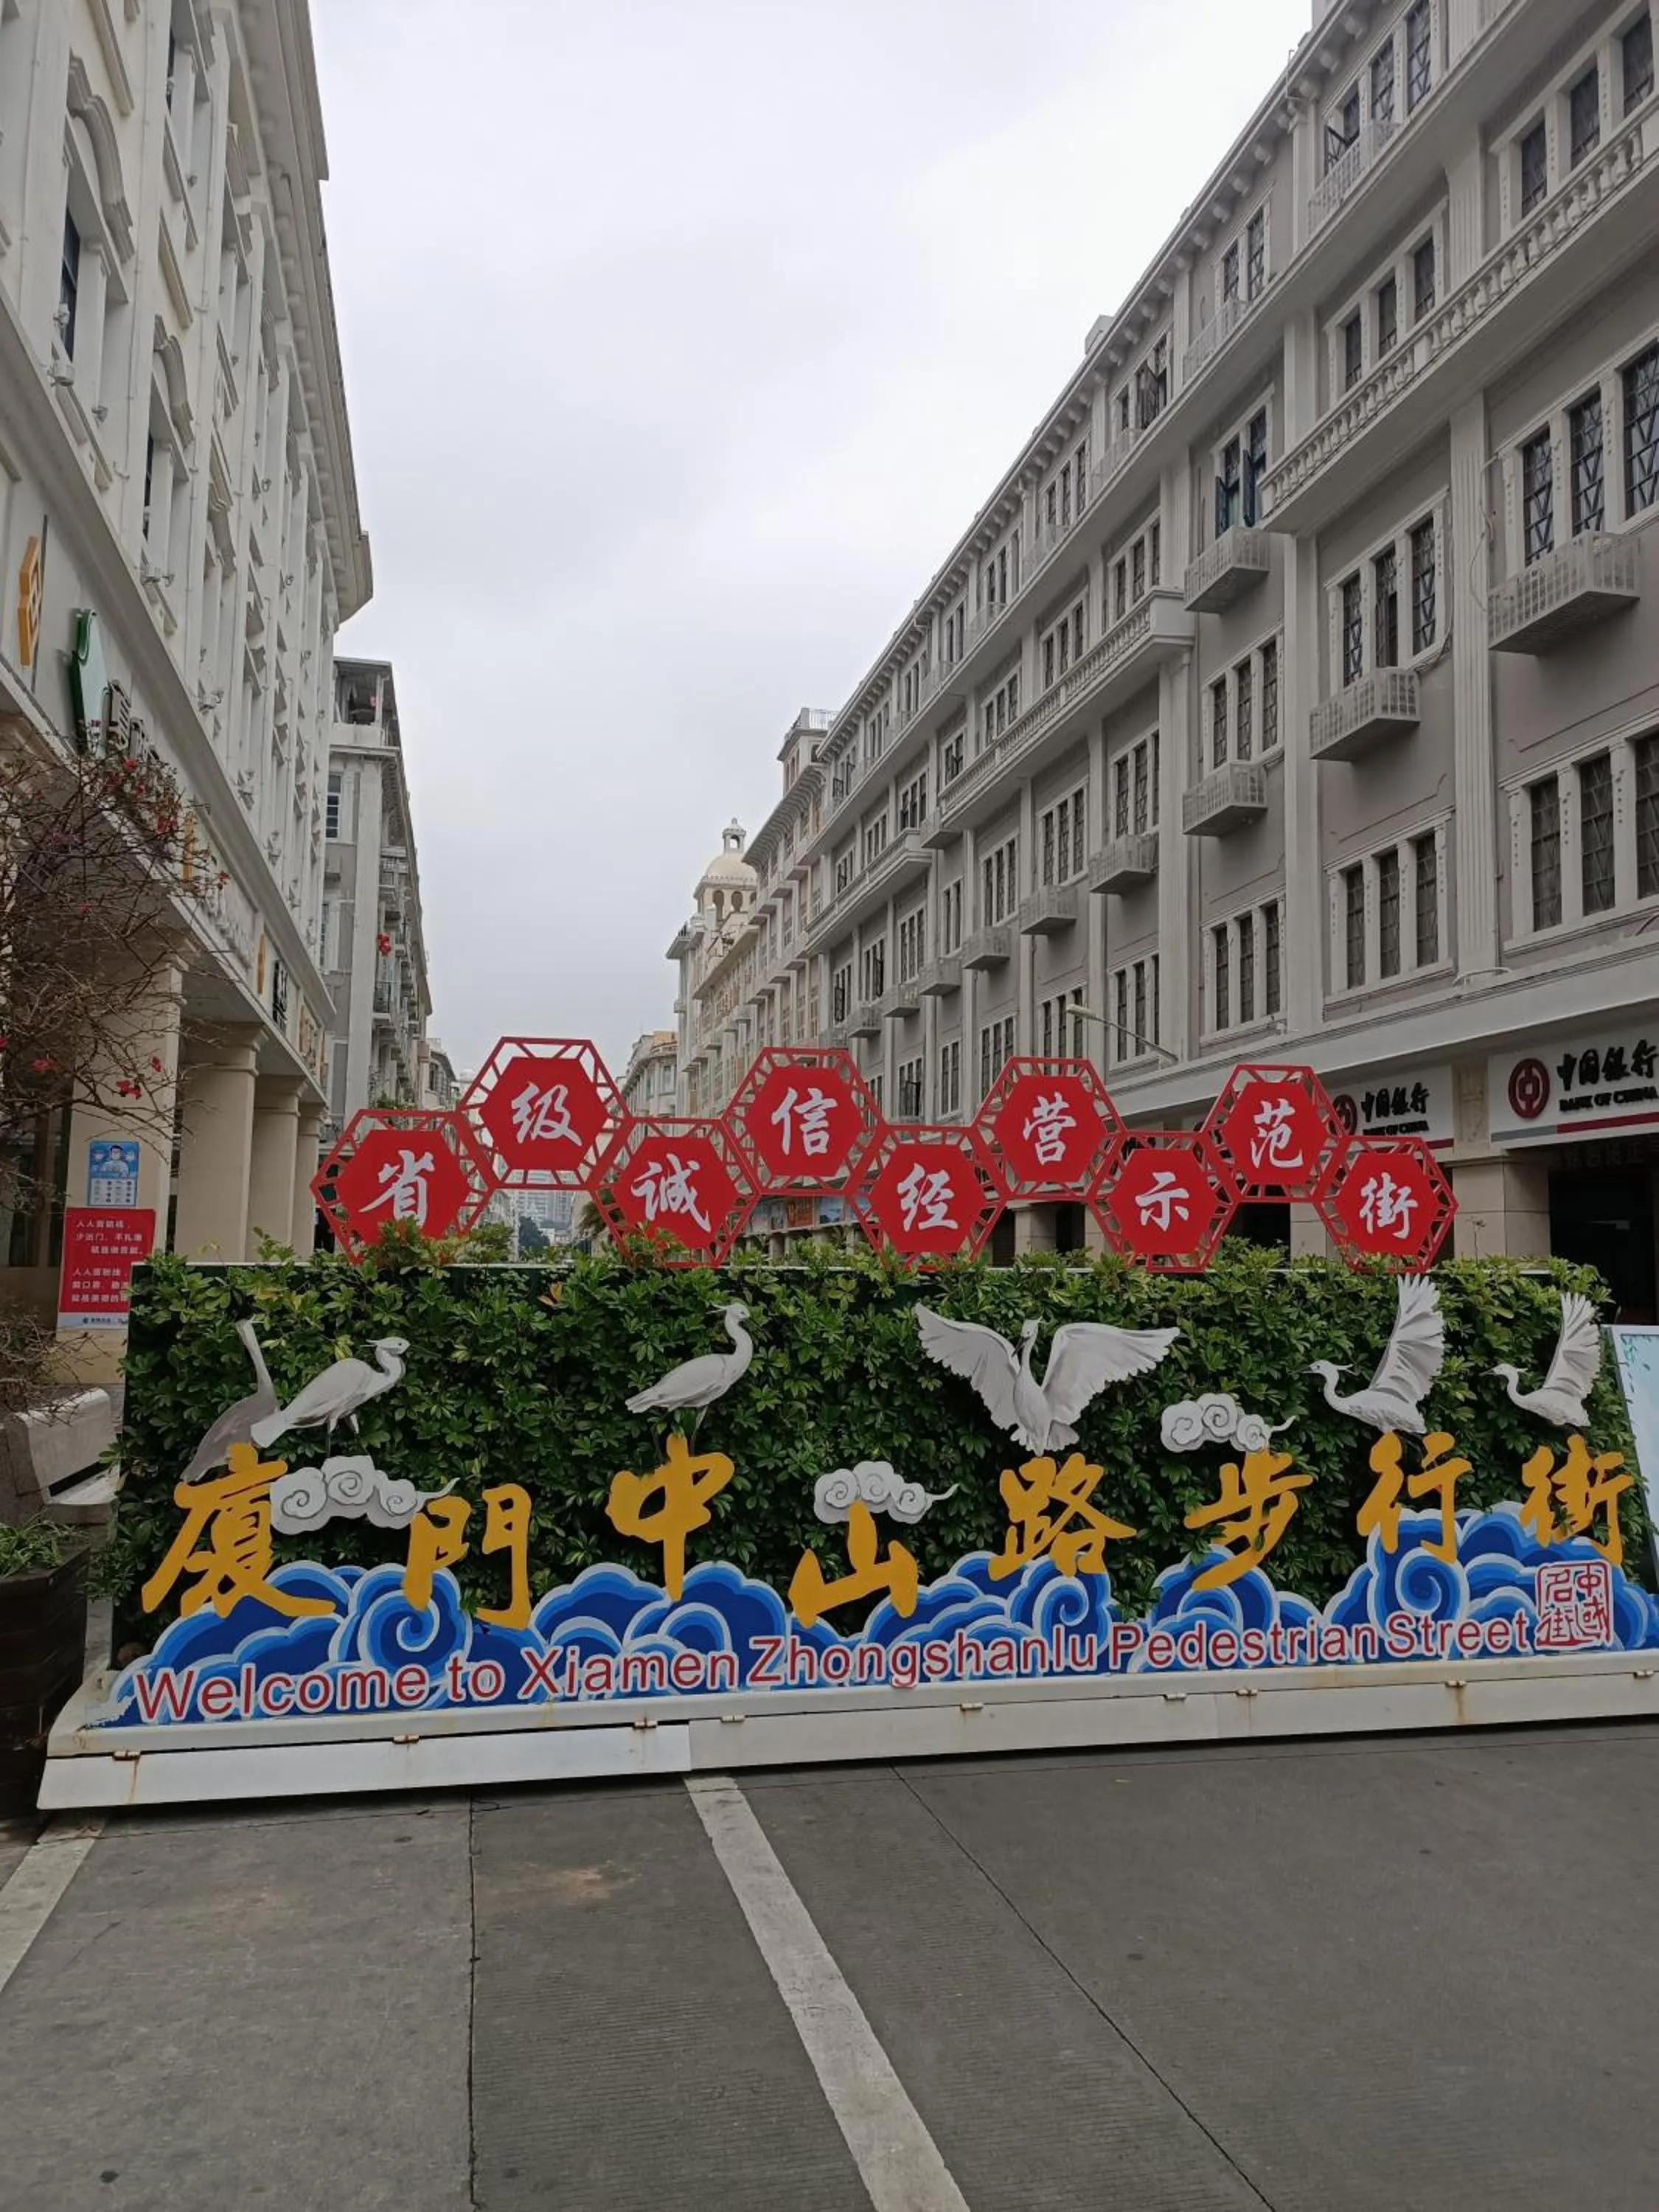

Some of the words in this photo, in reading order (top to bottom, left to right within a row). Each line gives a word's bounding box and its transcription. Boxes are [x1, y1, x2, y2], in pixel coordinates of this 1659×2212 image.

[137, 1667, 426, 1719] Welcome
[449, 1658, 501, 1698] to
[522, 1649, 735, 1695] Xiamen
[749, 1627, 1094, 1687] Zhongshanlu
[1112, 1624, 1377, 1666] Pedestrian
[1388, 1612, 1528, 1654] Street
